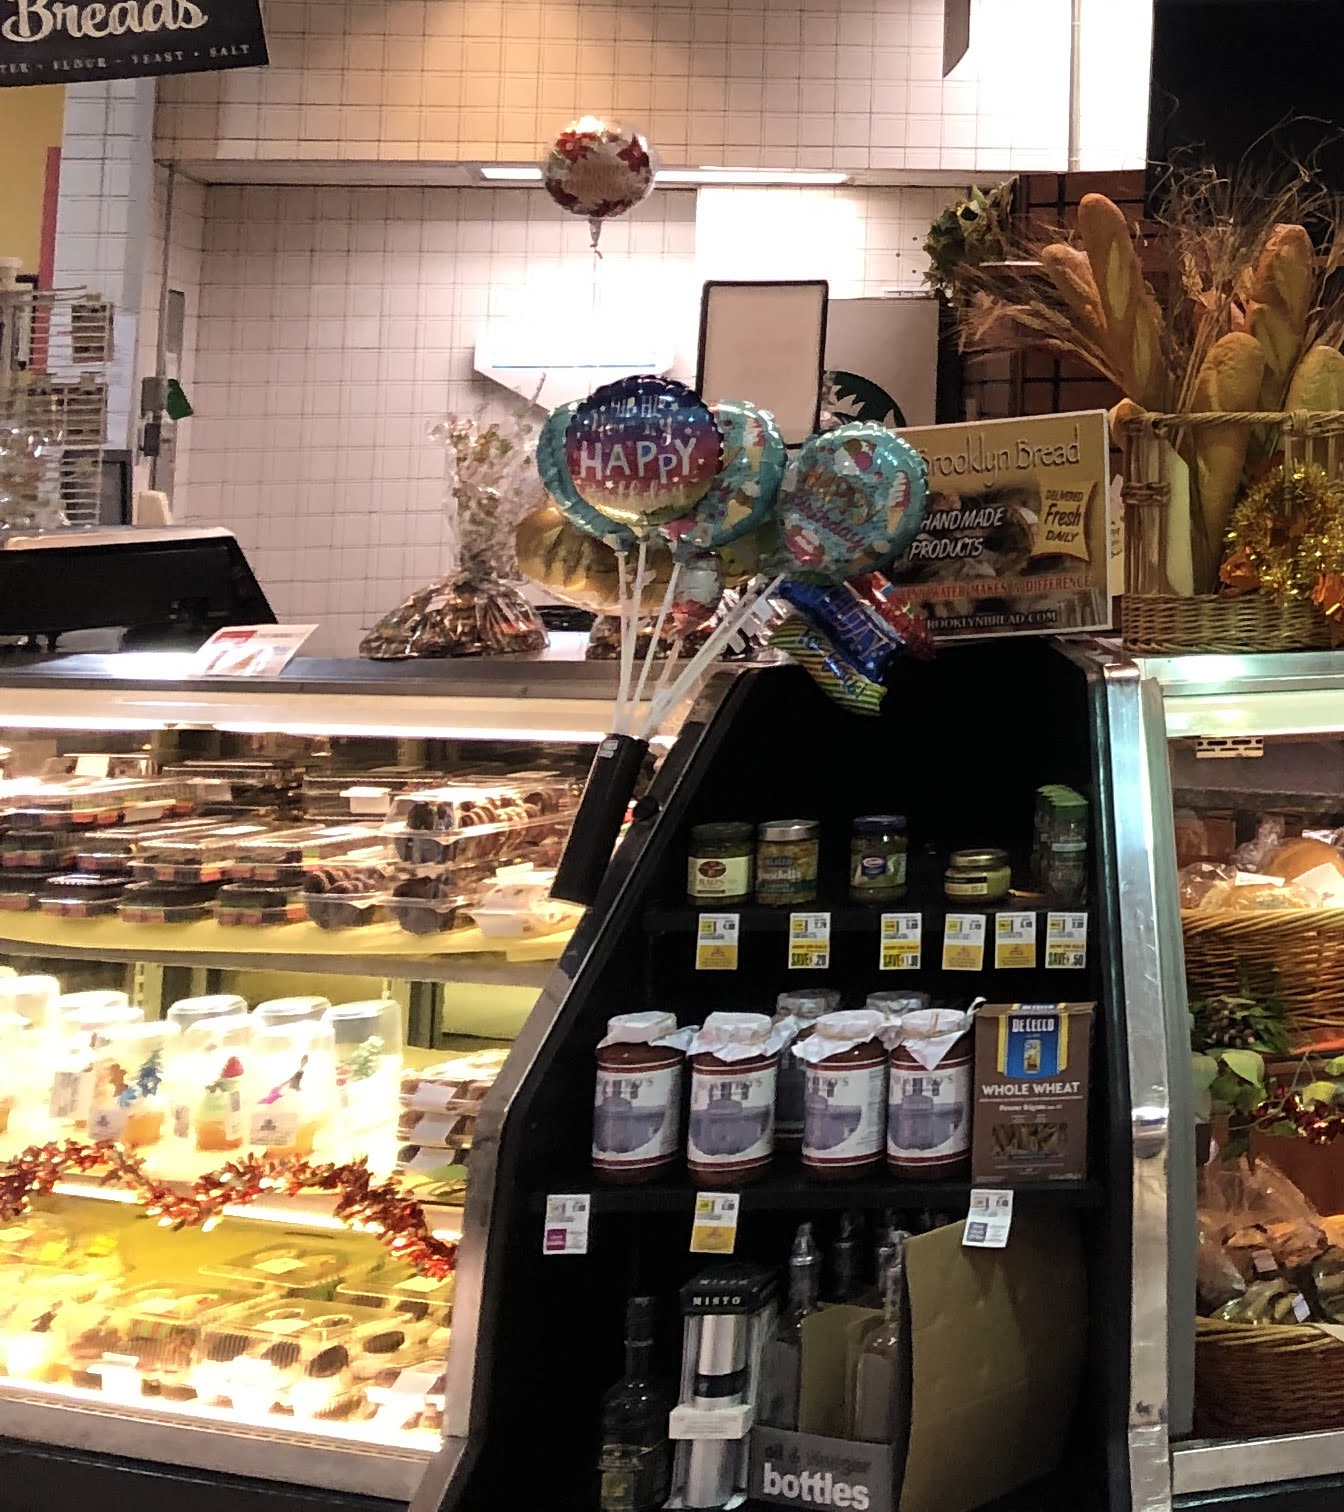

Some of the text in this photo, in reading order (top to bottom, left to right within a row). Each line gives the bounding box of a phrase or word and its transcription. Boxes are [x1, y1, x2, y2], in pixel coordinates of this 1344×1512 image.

[209, 44, 250, 58] SALT
[1014, 422, 1081, 471] Bread
[580, 436, 697, 485] HAPPY
[1044, 488, 1084, 503] DELIVERED
[920, 506, 1006, 532] HANDMADE
[1043, 503, 1082, 528] Fresh
[1044, 530, 1079, 543] DAILY
[908, 537, 984, 561] PRODUCTS
[971, 581, 1008, 597] MAKES
[927, 609, 1057, 631] ROOKLYNBREAD.COM
[1012, 1019, 1025, 1032] DE
[982, 1081, 1080, 1096] WHOLE WHEAT
[763, 1462, 870, 1511] bottles
